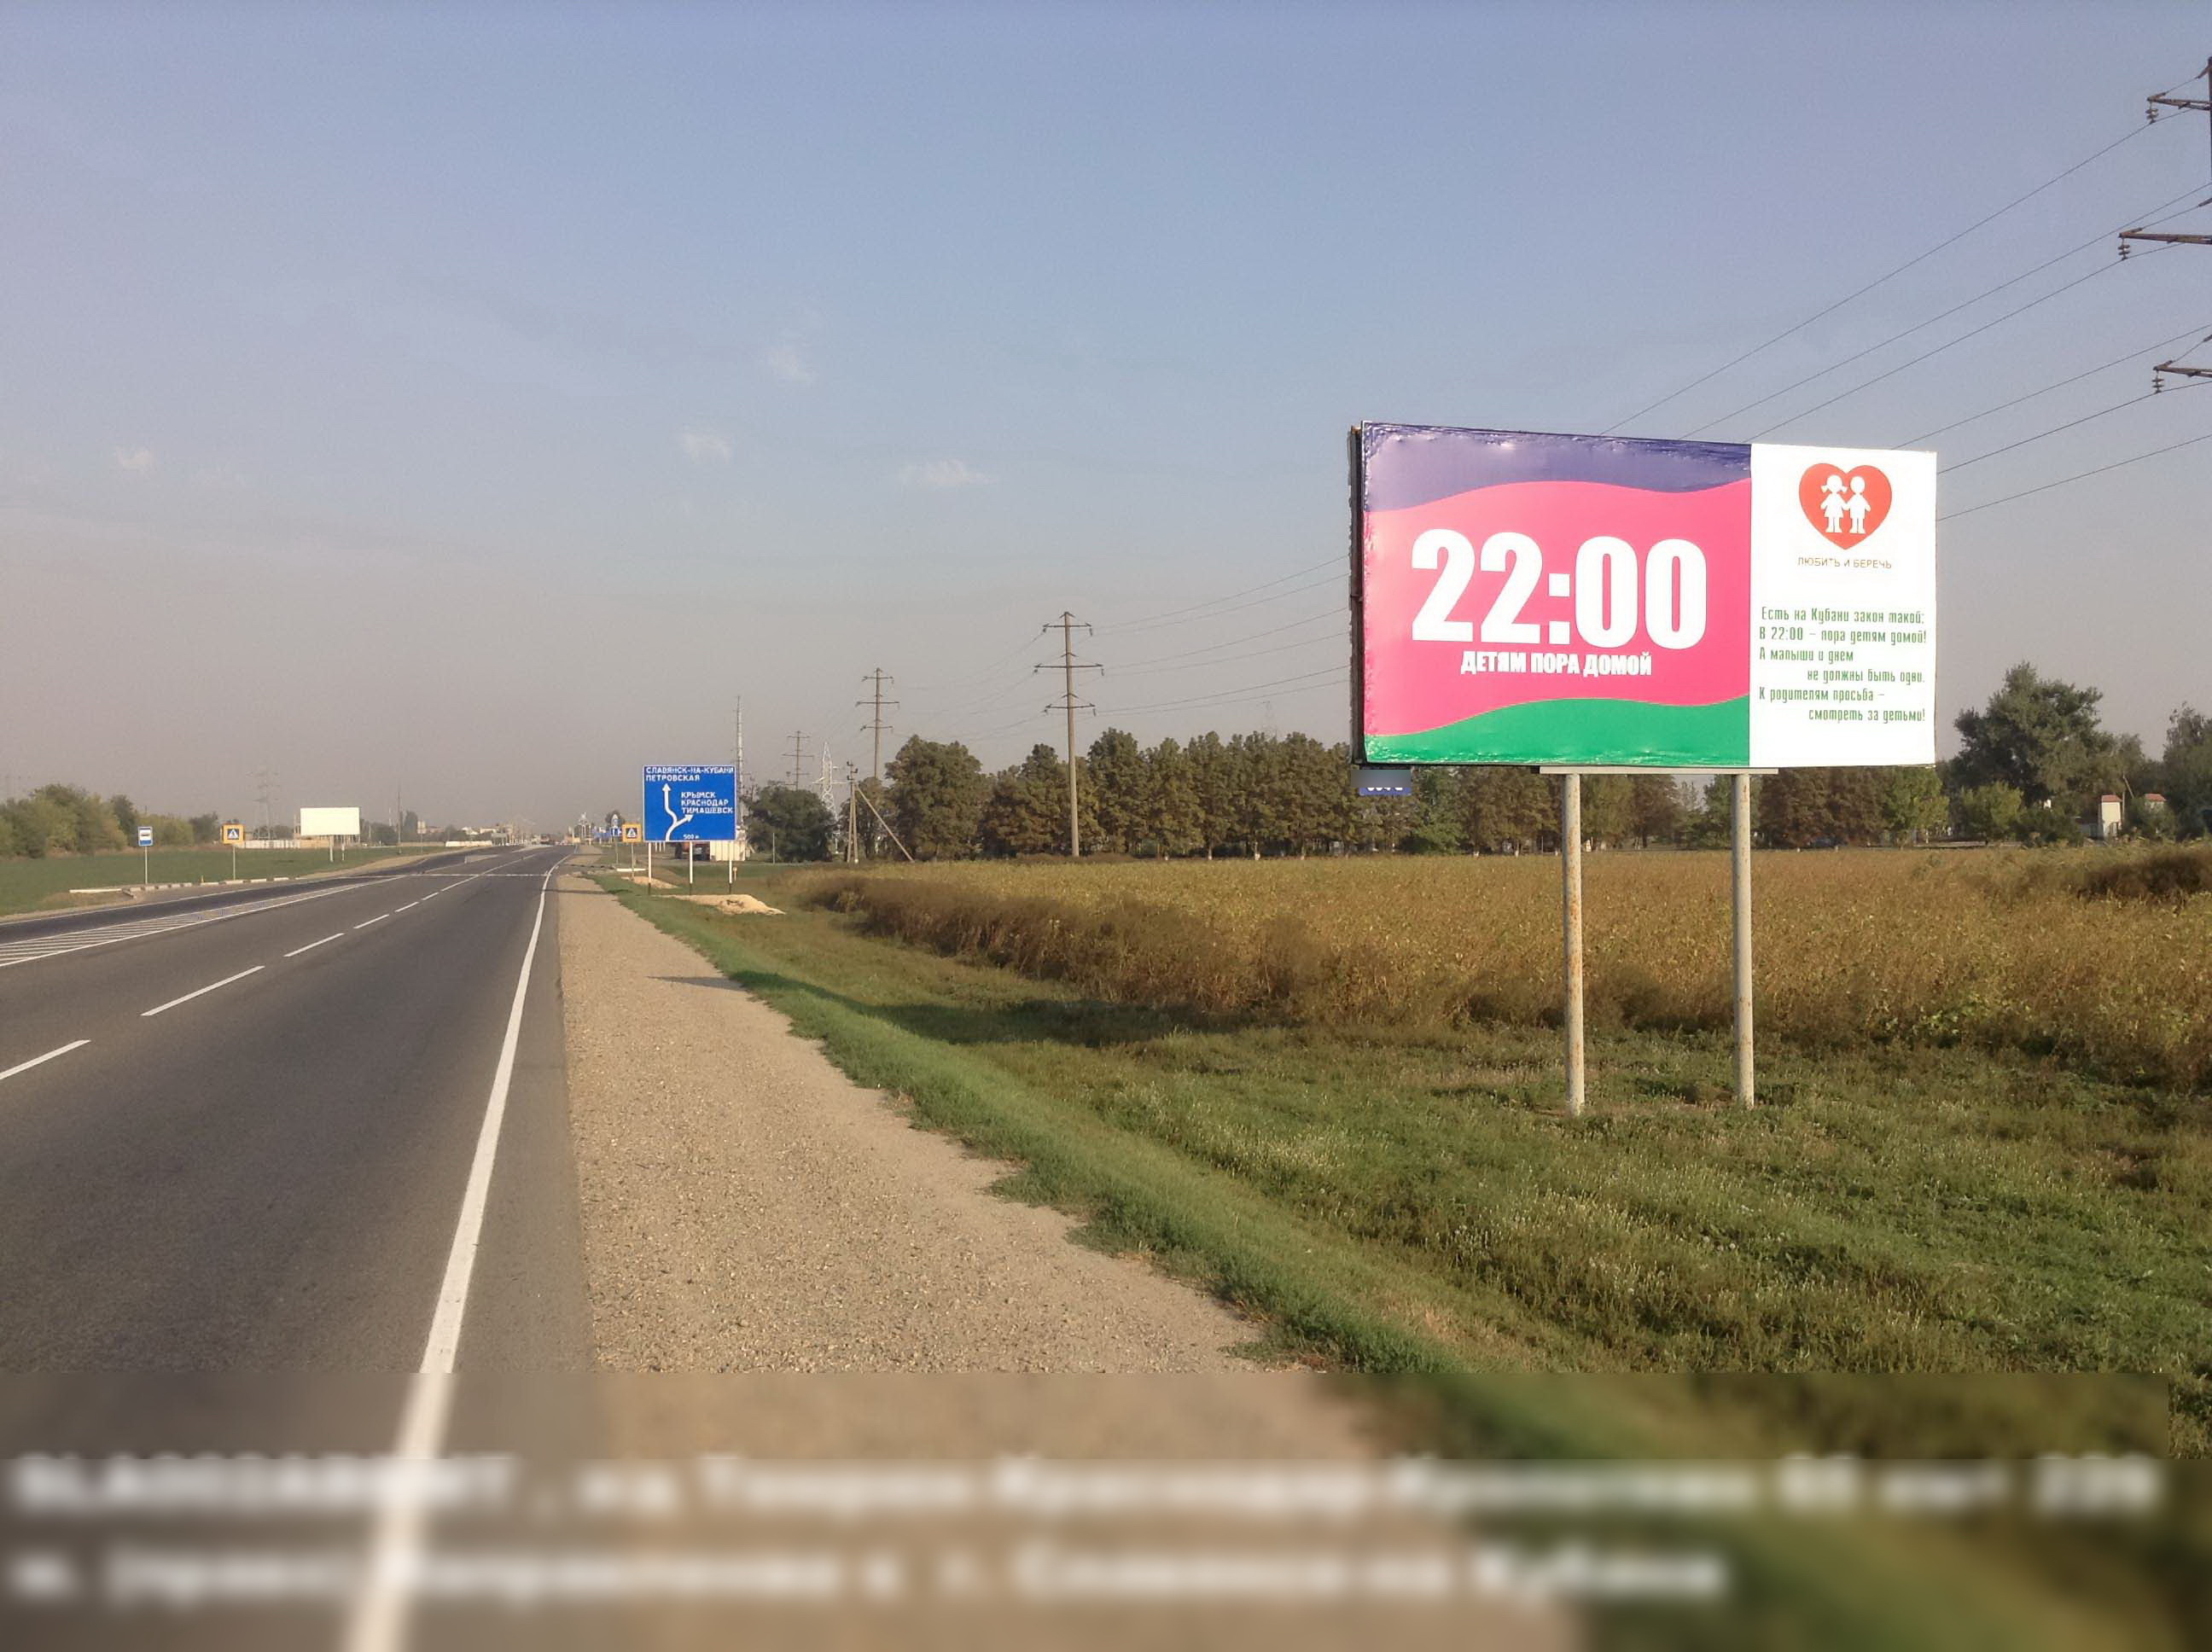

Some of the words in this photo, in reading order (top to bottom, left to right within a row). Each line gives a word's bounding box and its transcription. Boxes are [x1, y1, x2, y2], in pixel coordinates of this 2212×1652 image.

[1798, 556, 1841, 567] ЛЮБИТЬ
[1843, 559, 1850, 567] И
[1853, 559, 1892, 569] БЕРЕЧЬ
[1412, 529, 1707, 649] 22:00
[1761, 606, 1790, 621] Есть
[1794, 610, 1806, 621] на
[1811, 608, 1849, 625] Кубани
[1854, 611, 1883, 623] закон
[1759, 626, 1766, 640] В
[1771, 626, 1803, 641] 22:00
[1821, 629, 1845, 644] пора
[1850, 630, 1886, 645] детям
[1890, 630, 1927, 646] домой!
[1460, 650, 1526, 675] ДЕТЯМ
[1530, 653, 1580, 675] ПОРА
[1583, 651, 1652, 678] ДОМОЙ
[1760, 647, 1766, 660] А
[1770, 649, 1814, 661] малыши
[1819, 650, 1824, 661] и
[1828, 650, 1854, 665] днем
[1807, 669, 1819, 681] не
[1823, 669, 1863, 684] должны
[1867, 668, 1895, 683] быть
[1759, 687, 1766, 700] К
[1770, 689, 1829, 704] родителям
[1833, 689, 1874, 703] просьба
[1808, 709, 1864, 723] смотреть
[1867, 710, 1879, 721] за
[1883, 707, 1925, 724] детьми!
